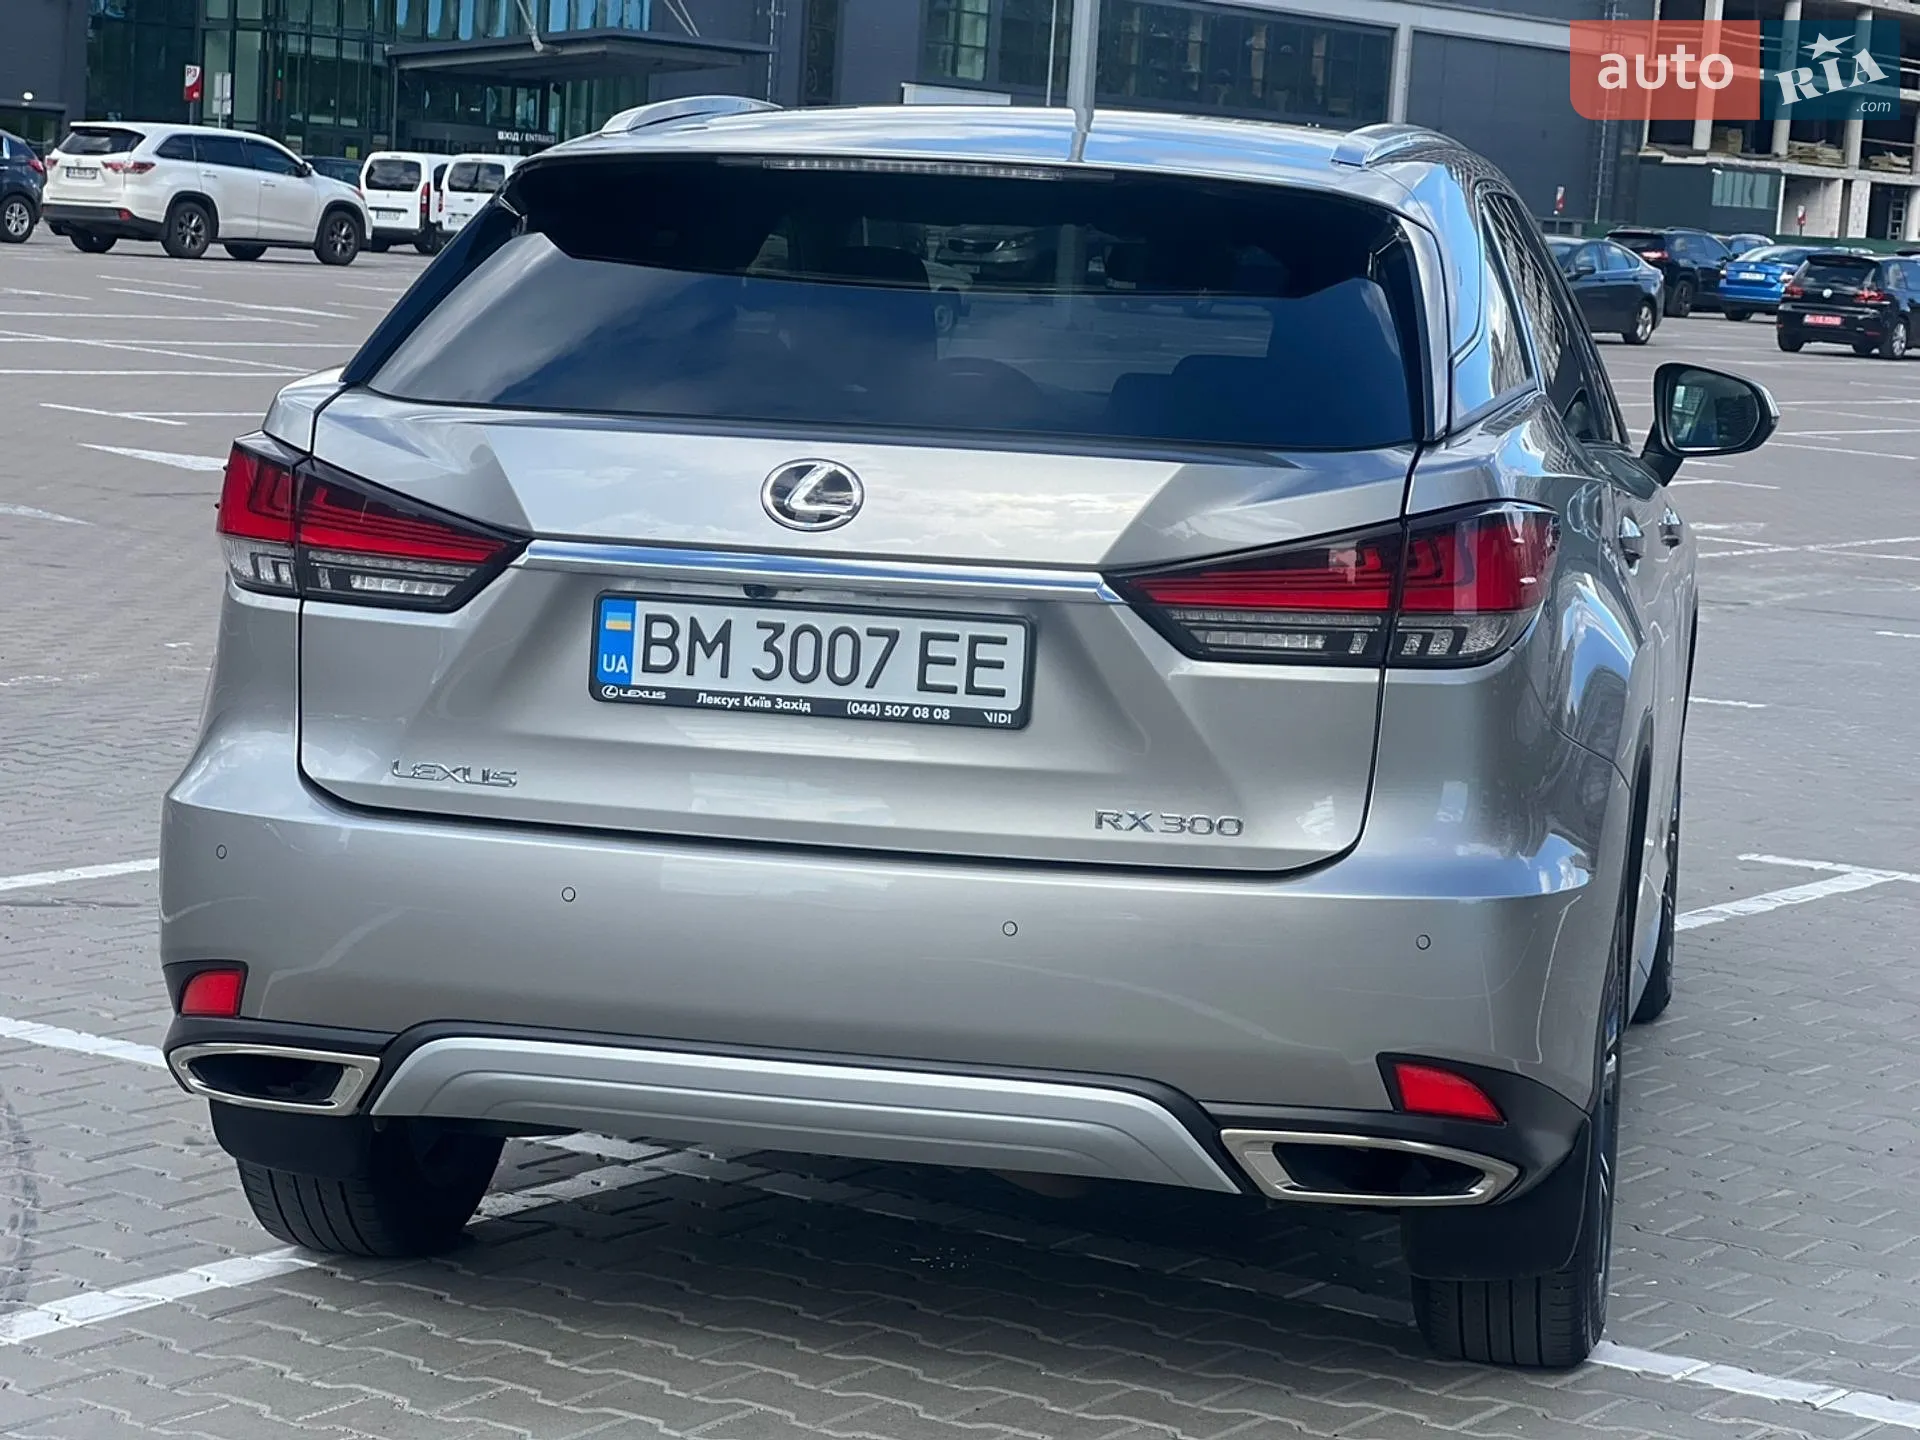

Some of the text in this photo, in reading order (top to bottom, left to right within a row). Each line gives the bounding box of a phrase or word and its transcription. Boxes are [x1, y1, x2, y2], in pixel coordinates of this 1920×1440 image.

[602, 653, 629, 674] UA
[641, 613, 1008, 698] BM 3007 EE
[619, 688, 667, 700] LEXUS
[697, 692, 812, 714] Лексус Київ Захід
[846, 701, 951, 721] (044) 507 08 08
[983, 711, 1012, 724] VIDI
[392, 759, 518, 788] LEXUS
[1095, 808, 1244, 837] RX 300
